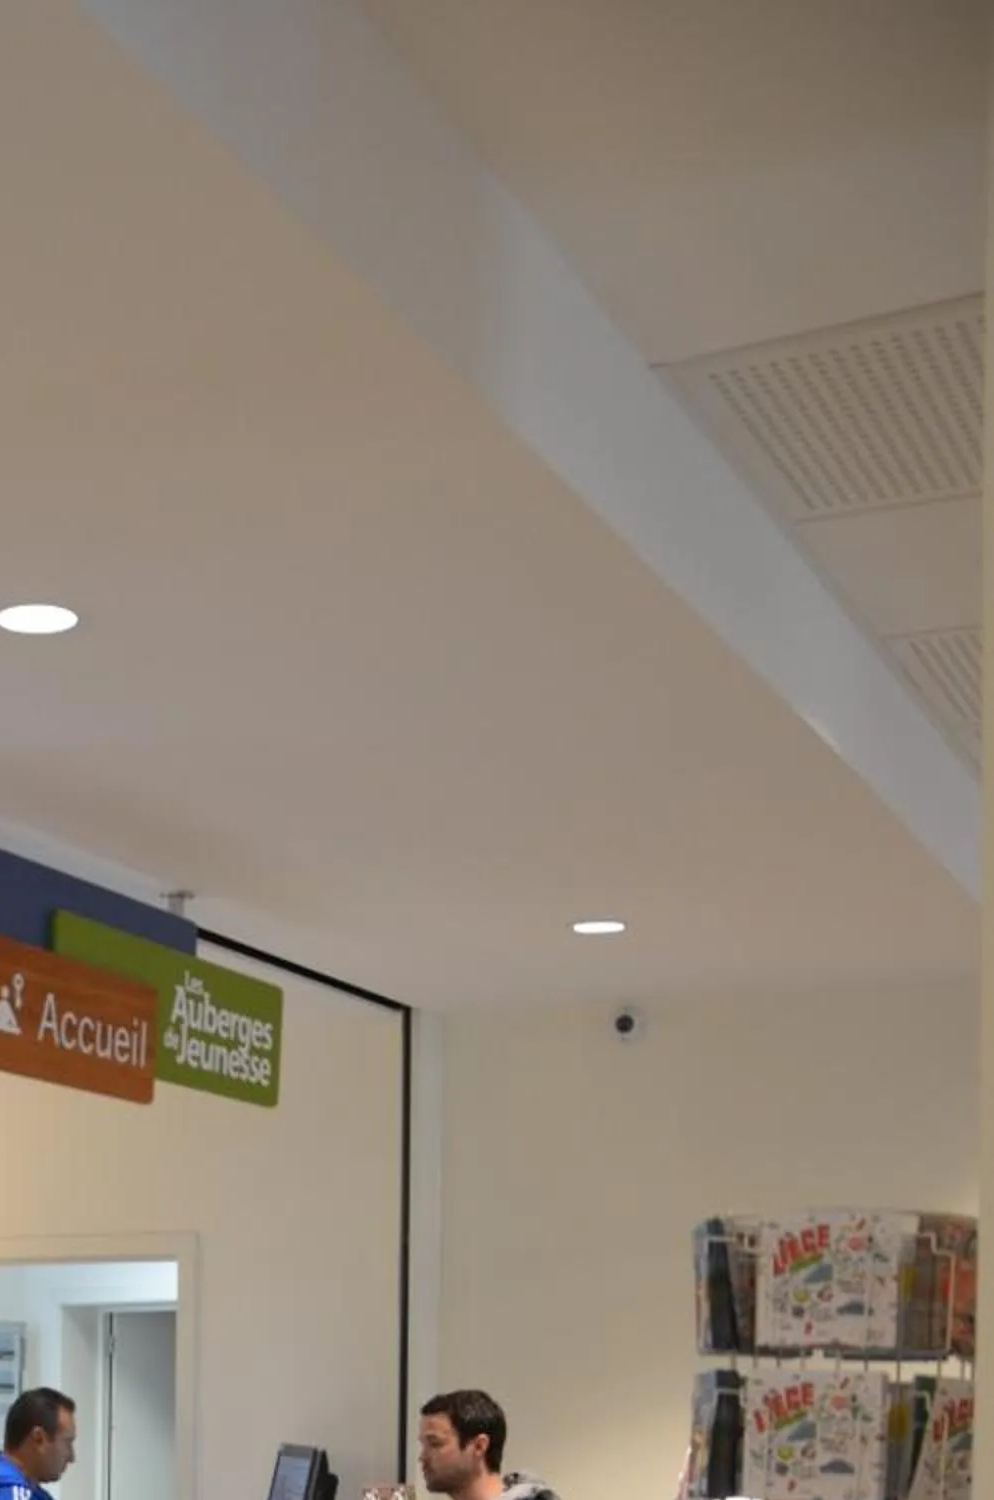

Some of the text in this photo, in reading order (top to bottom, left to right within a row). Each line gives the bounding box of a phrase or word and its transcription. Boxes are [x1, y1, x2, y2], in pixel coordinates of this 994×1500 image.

[184, 969, 204, 995] Les
[37, 993, 148, 1070] Accueil
[171, 985, 273, 1056] Auberges
[175, 1022, 271, 1087] Jeunesse
